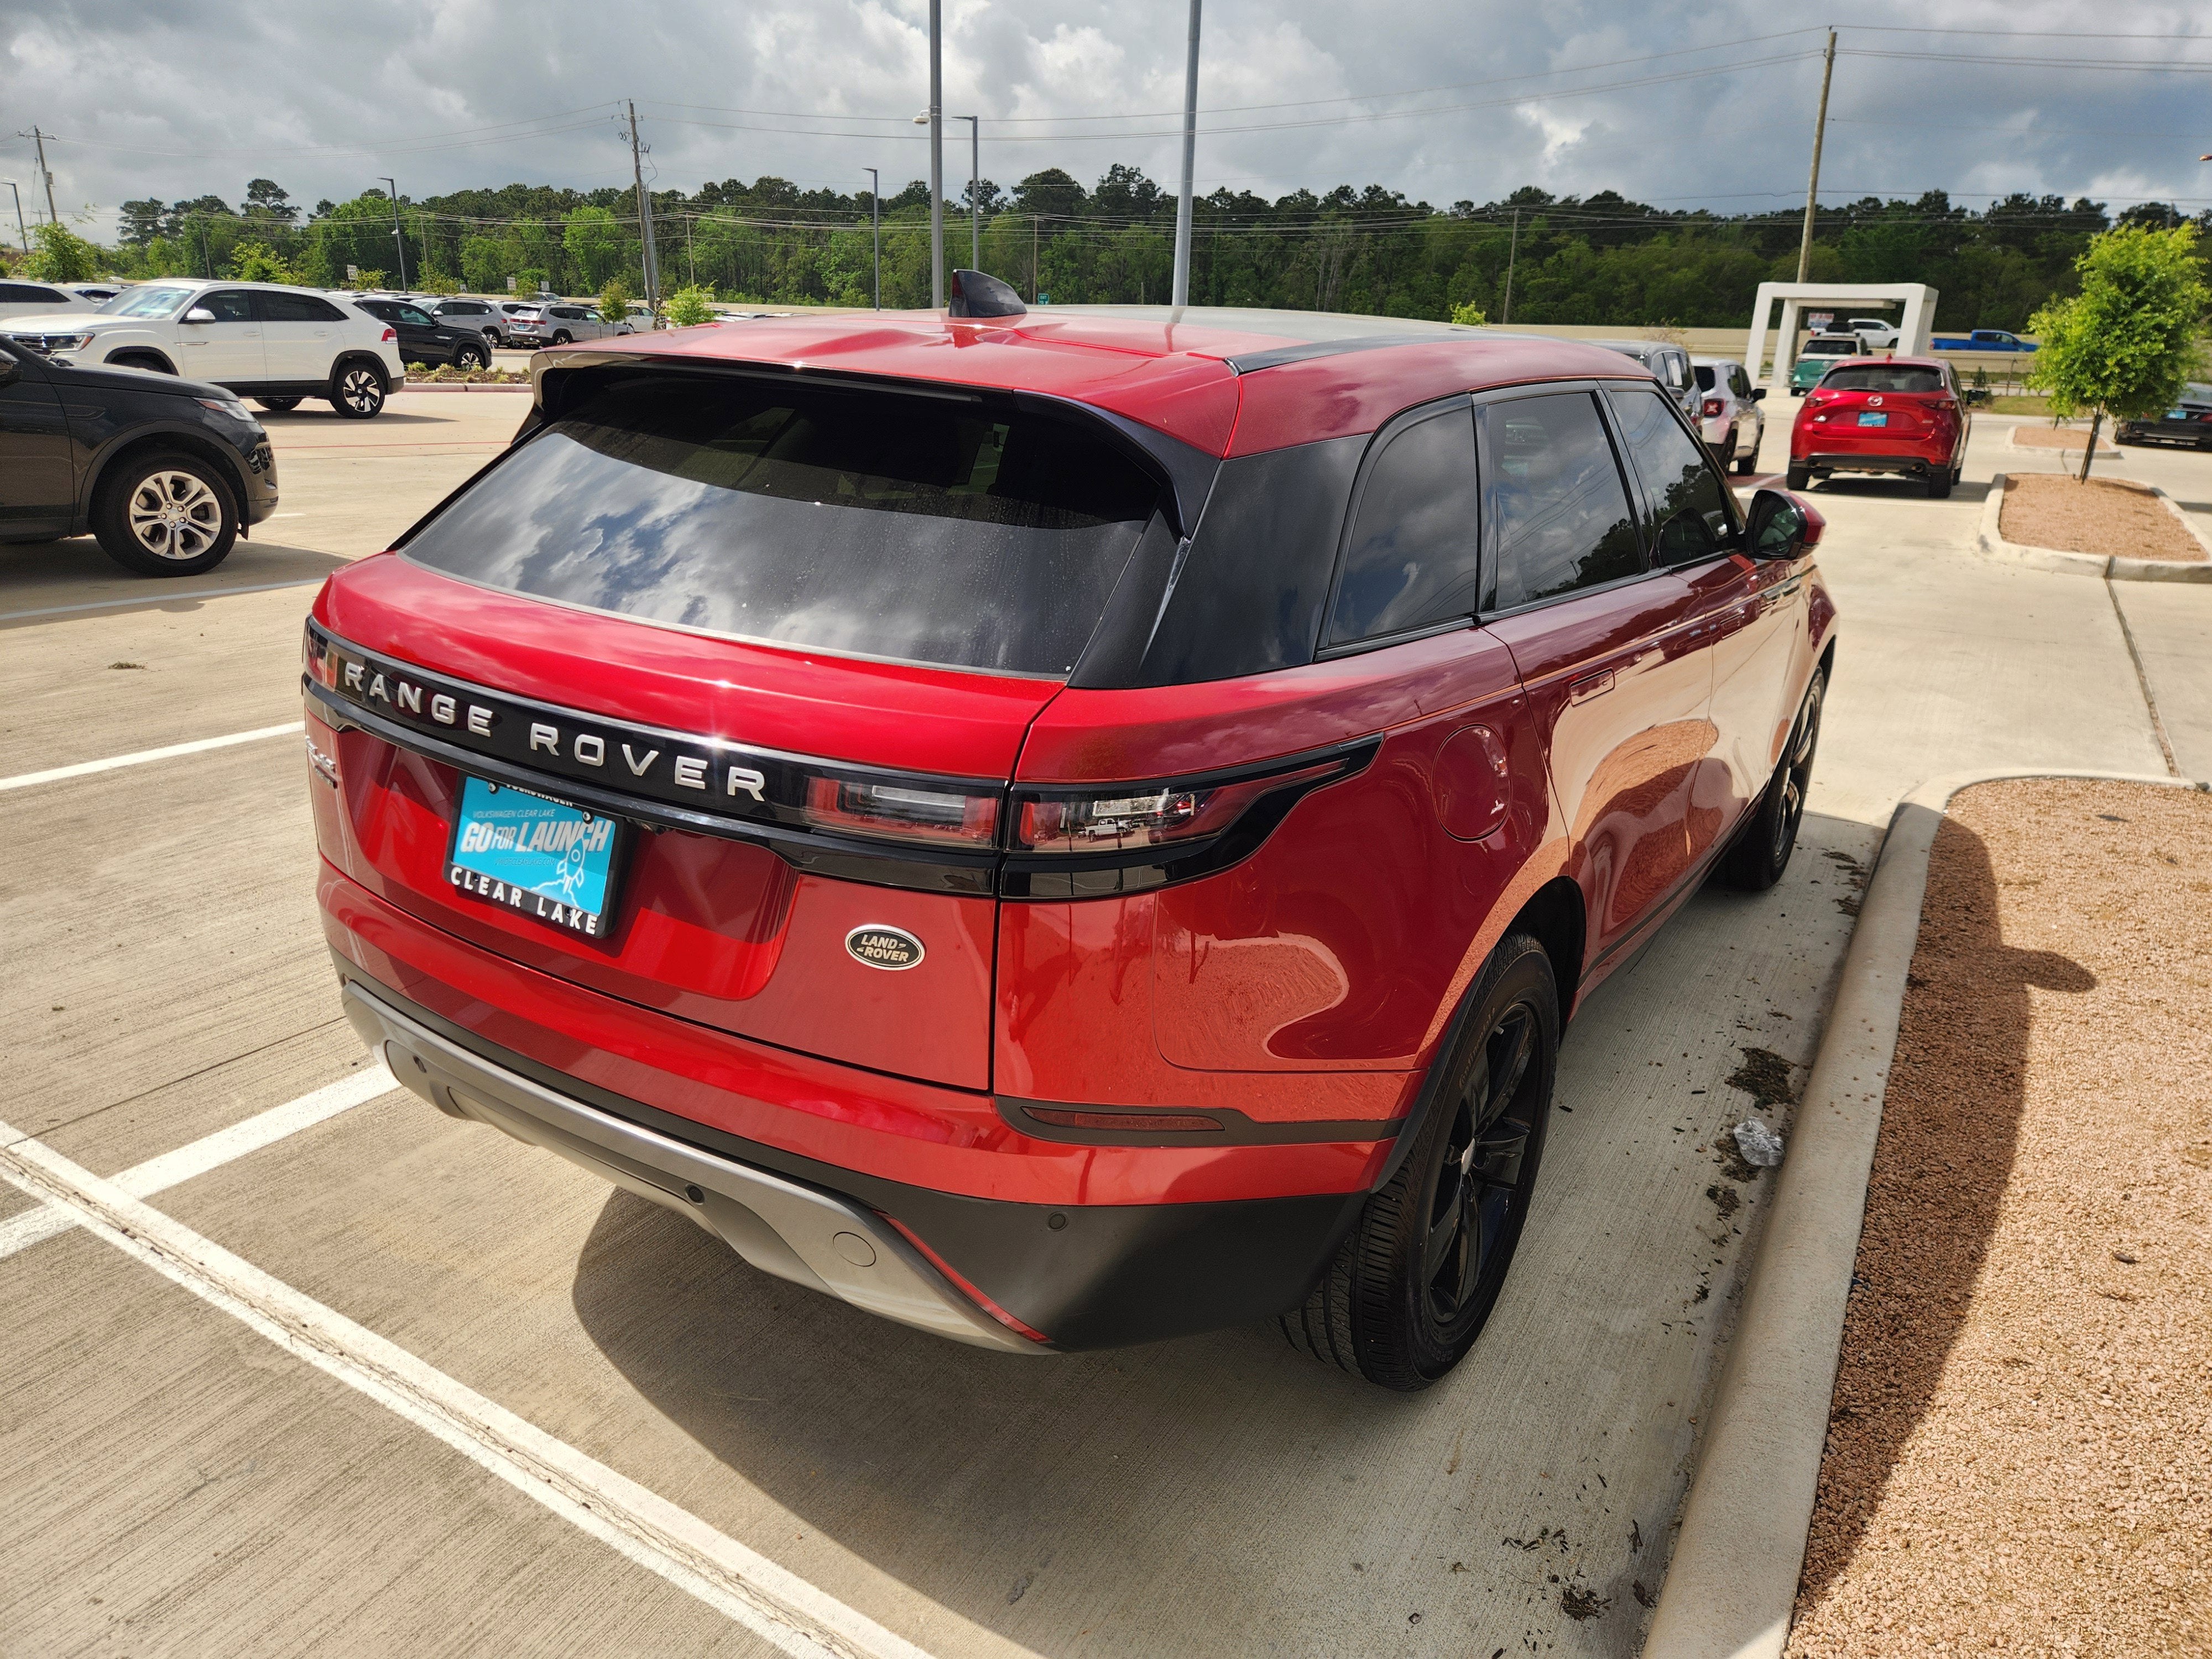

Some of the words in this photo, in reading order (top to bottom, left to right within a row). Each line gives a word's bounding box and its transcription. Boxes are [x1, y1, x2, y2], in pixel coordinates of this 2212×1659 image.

[345, 662, 493, 737] RANGE
[530, 722, 765, 802] ROVER
[473, 810, 517, 818] VOLKSWAGEN
[517, 810, 538, 818] CLEAR
[539, 809, 556, 817] LAKE
[460, 821, 494, 853] GO
[490, 827, 518, 850] FOR
[514, 820, 612, 853] LAUNCH
[451, 867, 522, 907] CLEAR
[536, 897, 598, 935] LAKE
[860, 934, 898, 950] LAND
[864, 946, 909, 962] ROVER
